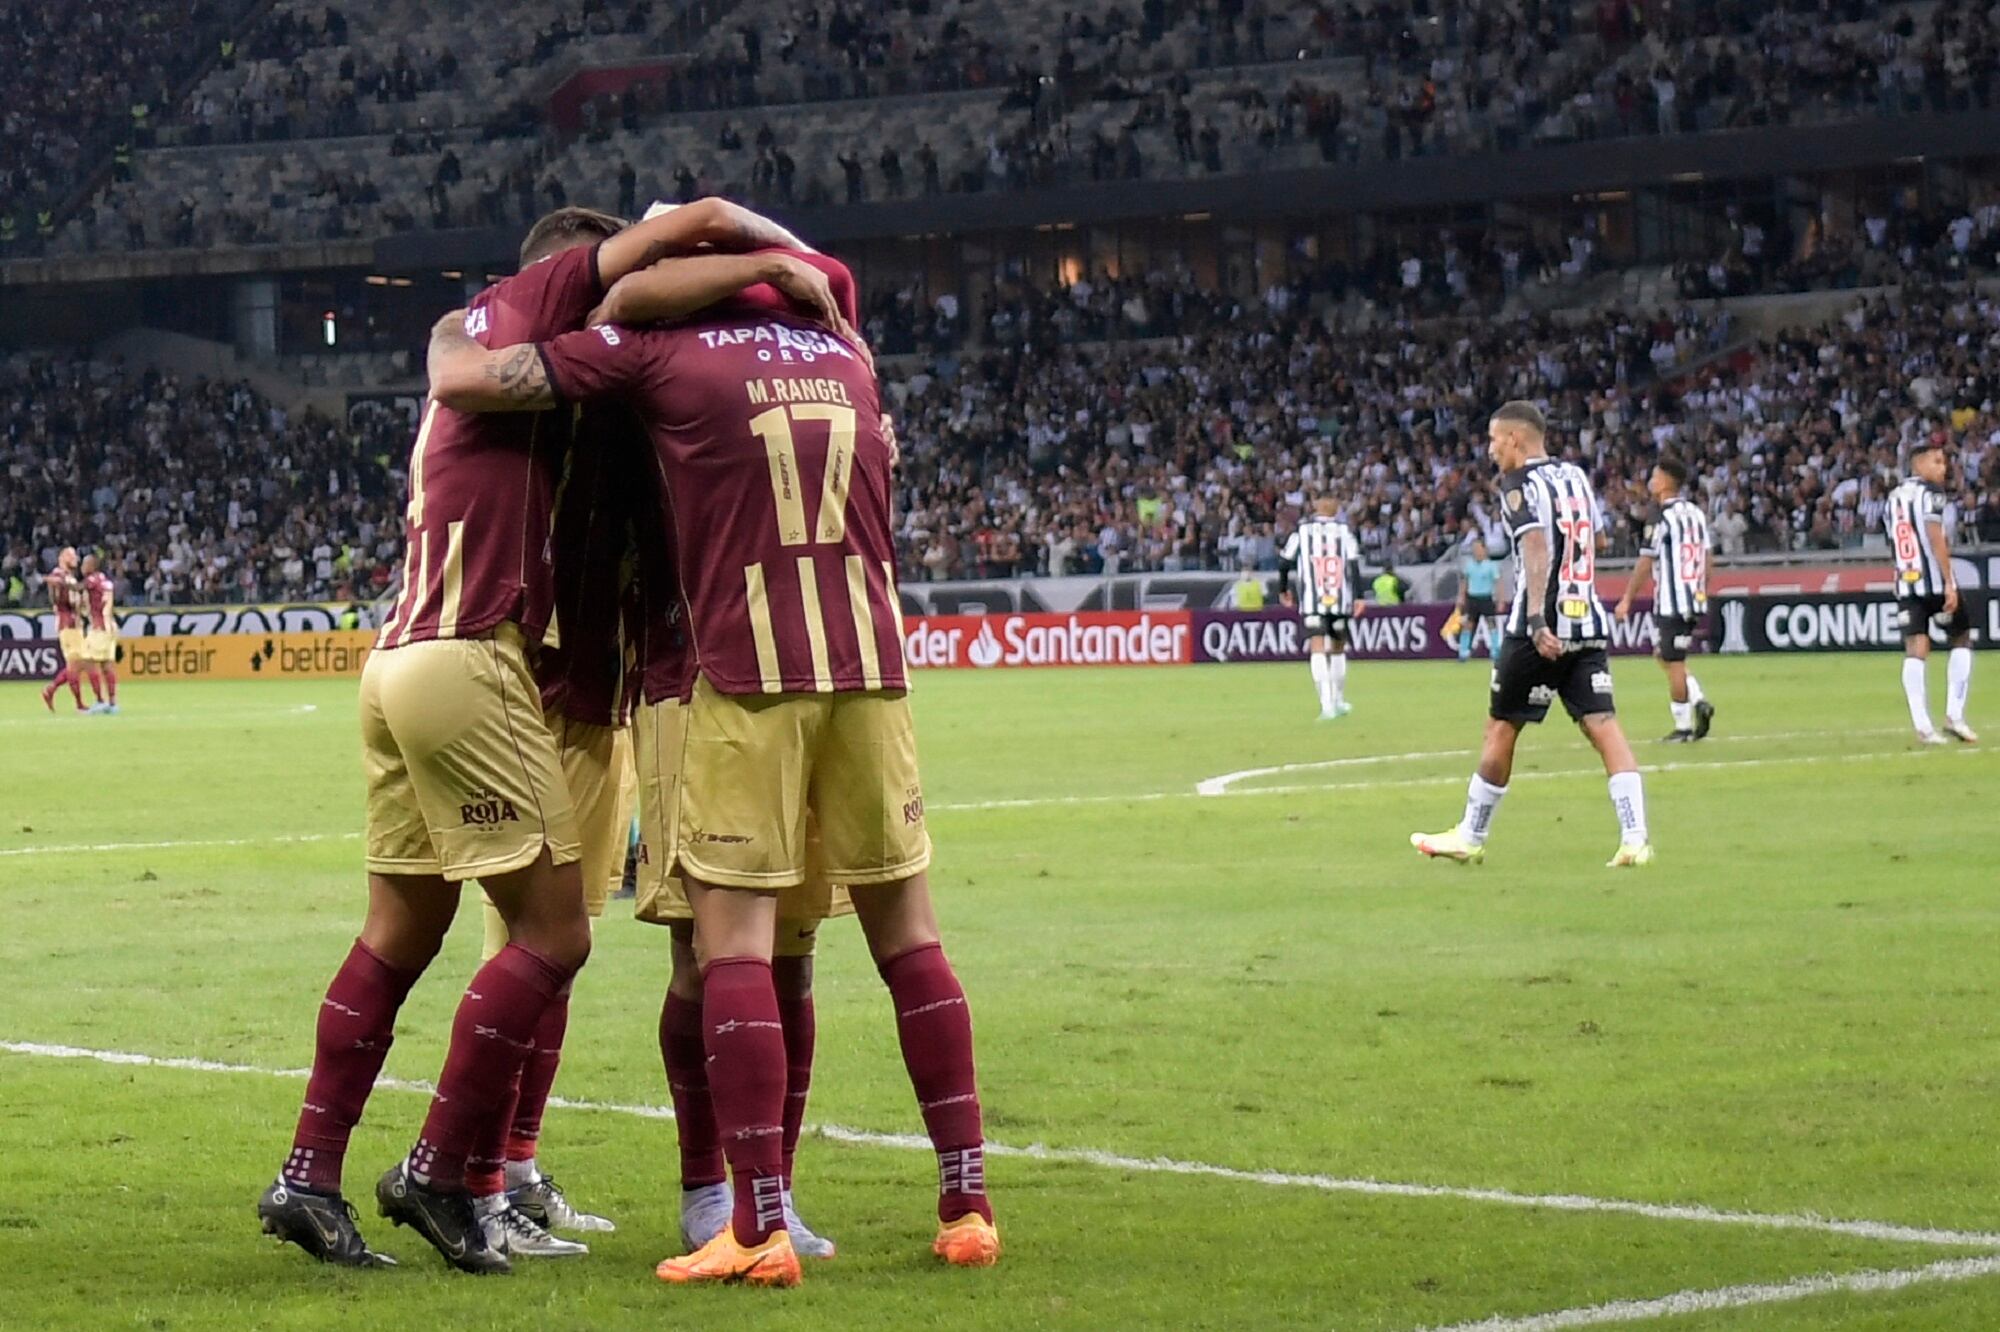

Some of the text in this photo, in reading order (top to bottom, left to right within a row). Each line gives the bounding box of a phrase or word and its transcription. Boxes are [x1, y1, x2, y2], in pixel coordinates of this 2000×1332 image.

[699, 326, 774, 349] TAPA
[757, 349, 816, 362] ORO
[745, 378, 852, 405] M.RANGEL
[749, 403, 856, 546] 17
[280, 638, 366, 672] betfair
[1004, 615, 1188, 664] Santander
[1203, 619, 1298, 662] QATAR
[130, 641, 216, 674] betfair
[460, 800, 520, 824] ROJA
